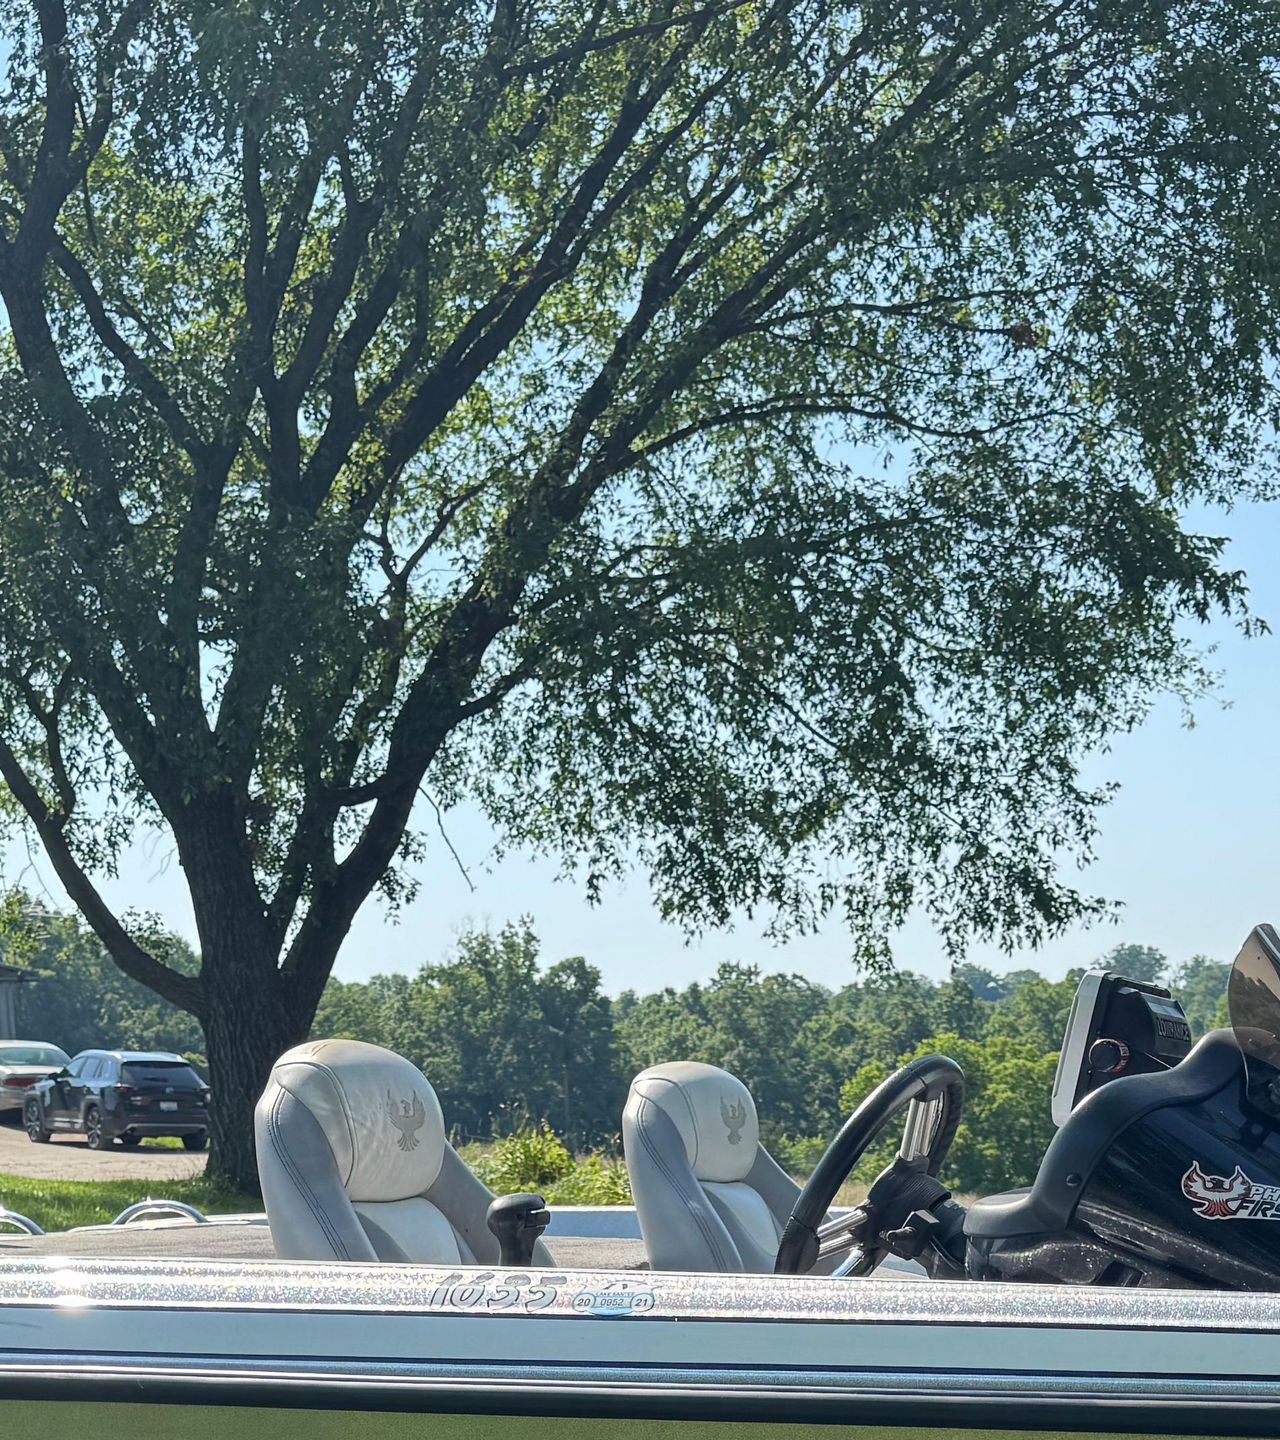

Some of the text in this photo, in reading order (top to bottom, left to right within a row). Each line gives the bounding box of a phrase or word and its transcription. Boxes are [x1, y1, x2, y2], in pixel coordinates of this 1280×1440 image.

[577, 1298, 648, 1307] 20 0952 21
